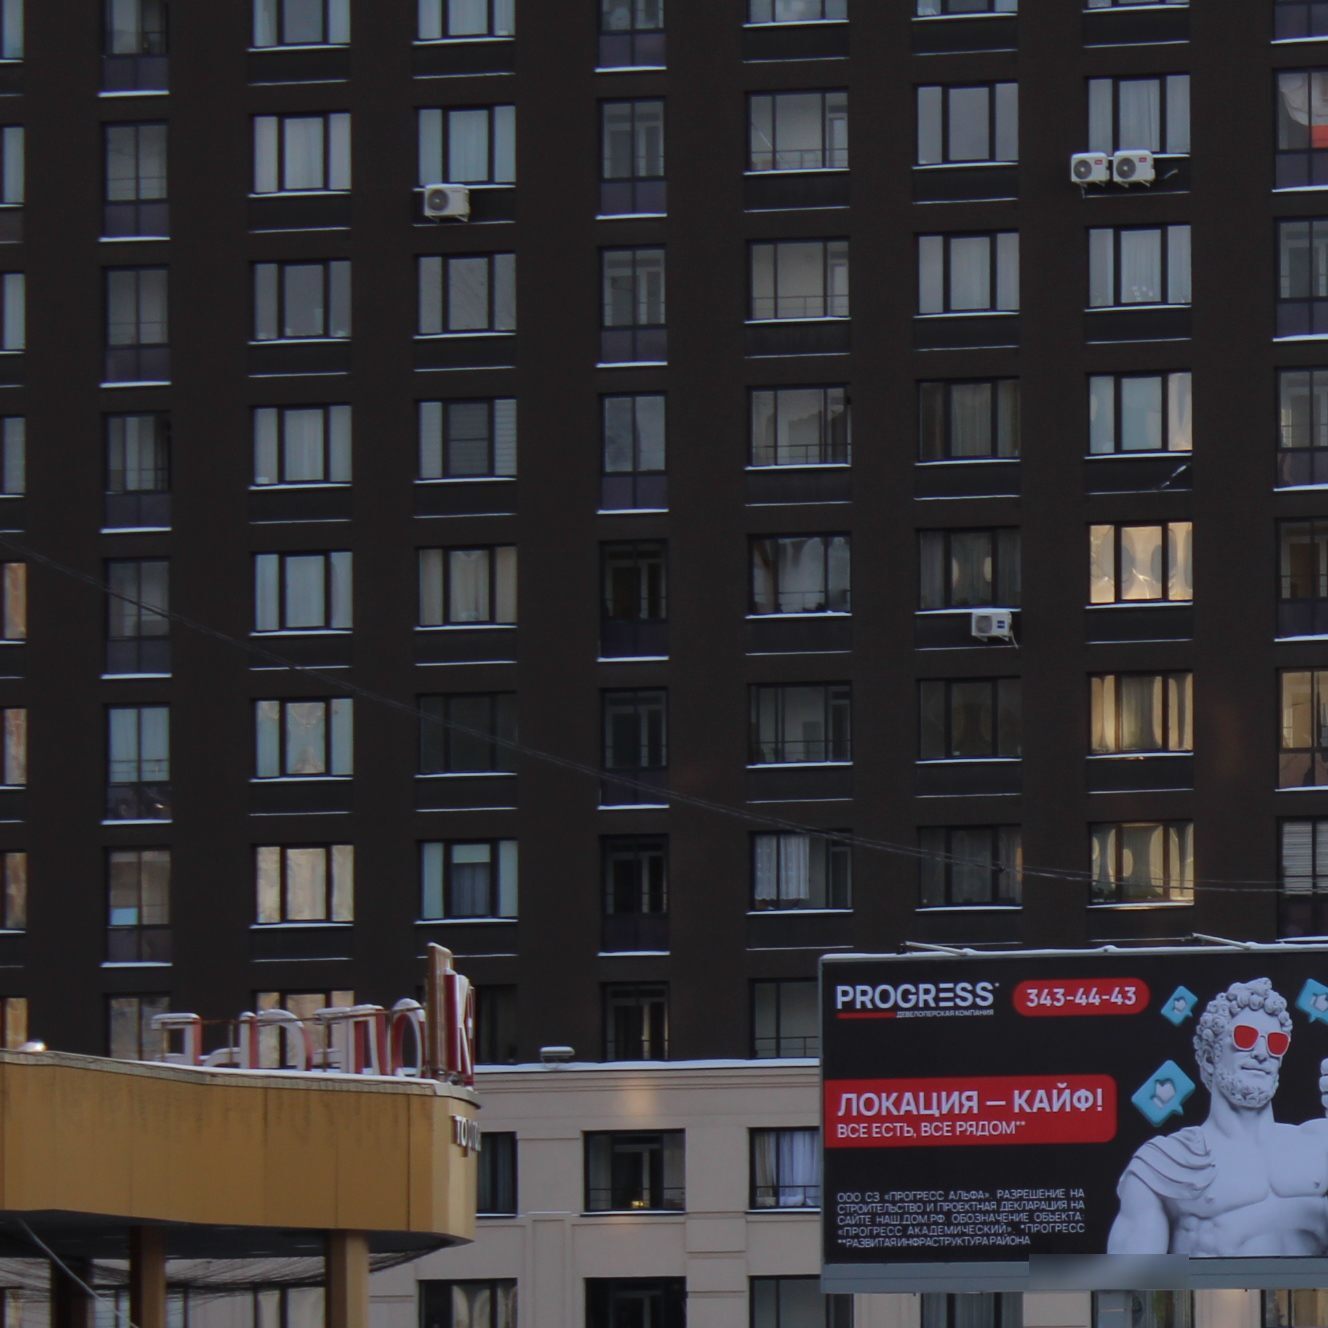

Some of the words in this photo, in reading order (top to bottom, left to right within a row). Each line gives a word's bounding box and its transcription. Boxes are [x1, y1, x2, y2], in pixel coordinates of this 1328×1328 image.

[1026, 986, 1136, 1007] 343-44-43
[837, 1091, 979, 1117] ЛОКАЦИЯ
[1013, 1083, 1103, 1113] КАЙФ!
[837, 1123, 869, 1138] ВСЕ
[872, 1123, 917, 1139] ЕСТЬ,
[921, 1122, 952, 1136] ВСЕ
[837, 1192, 862, 1202] ООО
[884, 1191, 945, 1201] «ПРОГРЕСС
[996, 1189, 1066, 1199] РАЗРЕШЕНИЕ
[1070, 1188, 1085, 1198] НА
[837, 1203, 924, 1214] СТРОИТЕЛЬСТВО
[926, 1203, 935, 1212] И
[937, 1202, 997, 1212] ПРОЕКТНАЯ
[1000, 1200, 1067, 1211] ДЕКЛАРАЦИЯ
[1070, 1200, 1085, 1210] НА
[837, 1214, 872, 1225] САЙТЕ
[951, 1212, 1029, 1223] ОБОЗНАЧЕНИЕ
[838, 1226, 903, 1237] «ПРОГРЕСС
